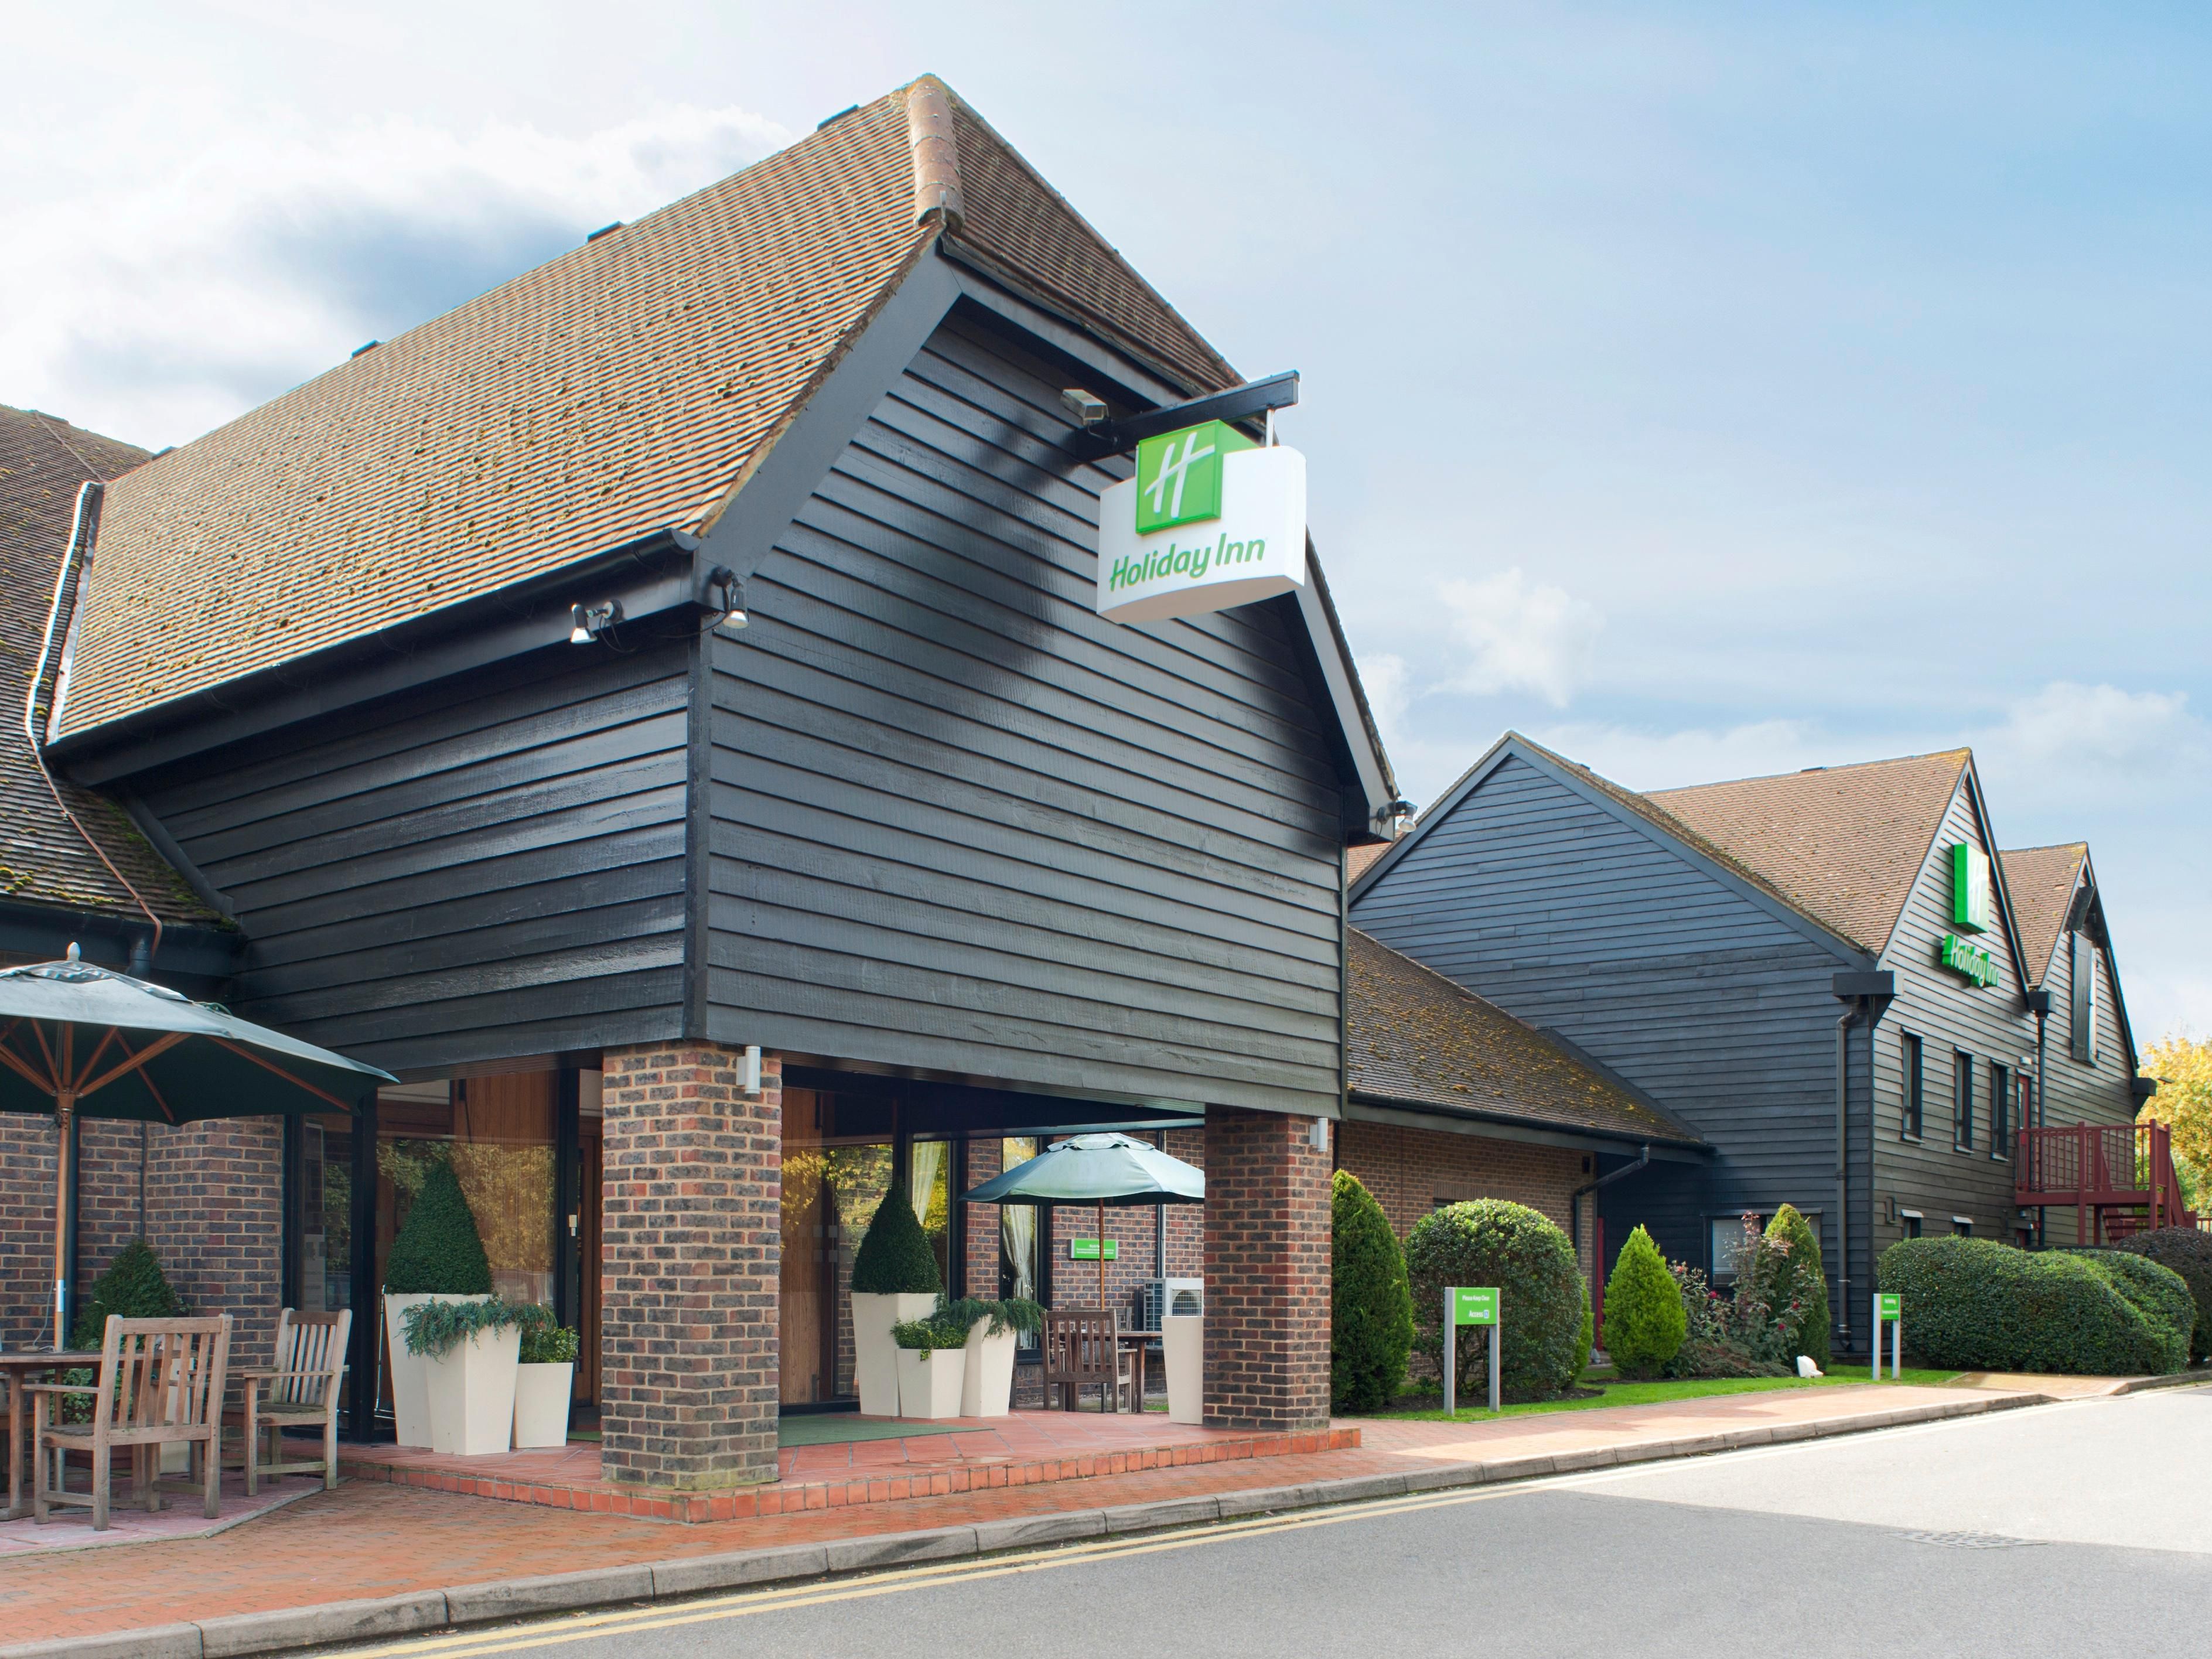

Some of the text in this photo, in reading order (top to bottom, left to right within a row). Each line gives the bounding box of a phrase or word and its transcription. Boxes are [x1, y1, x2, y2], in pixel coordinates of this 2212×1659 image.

[1109, 532, 1266, 592] Holiday Inn
[1945, 934, 1986, 987] Holiday
